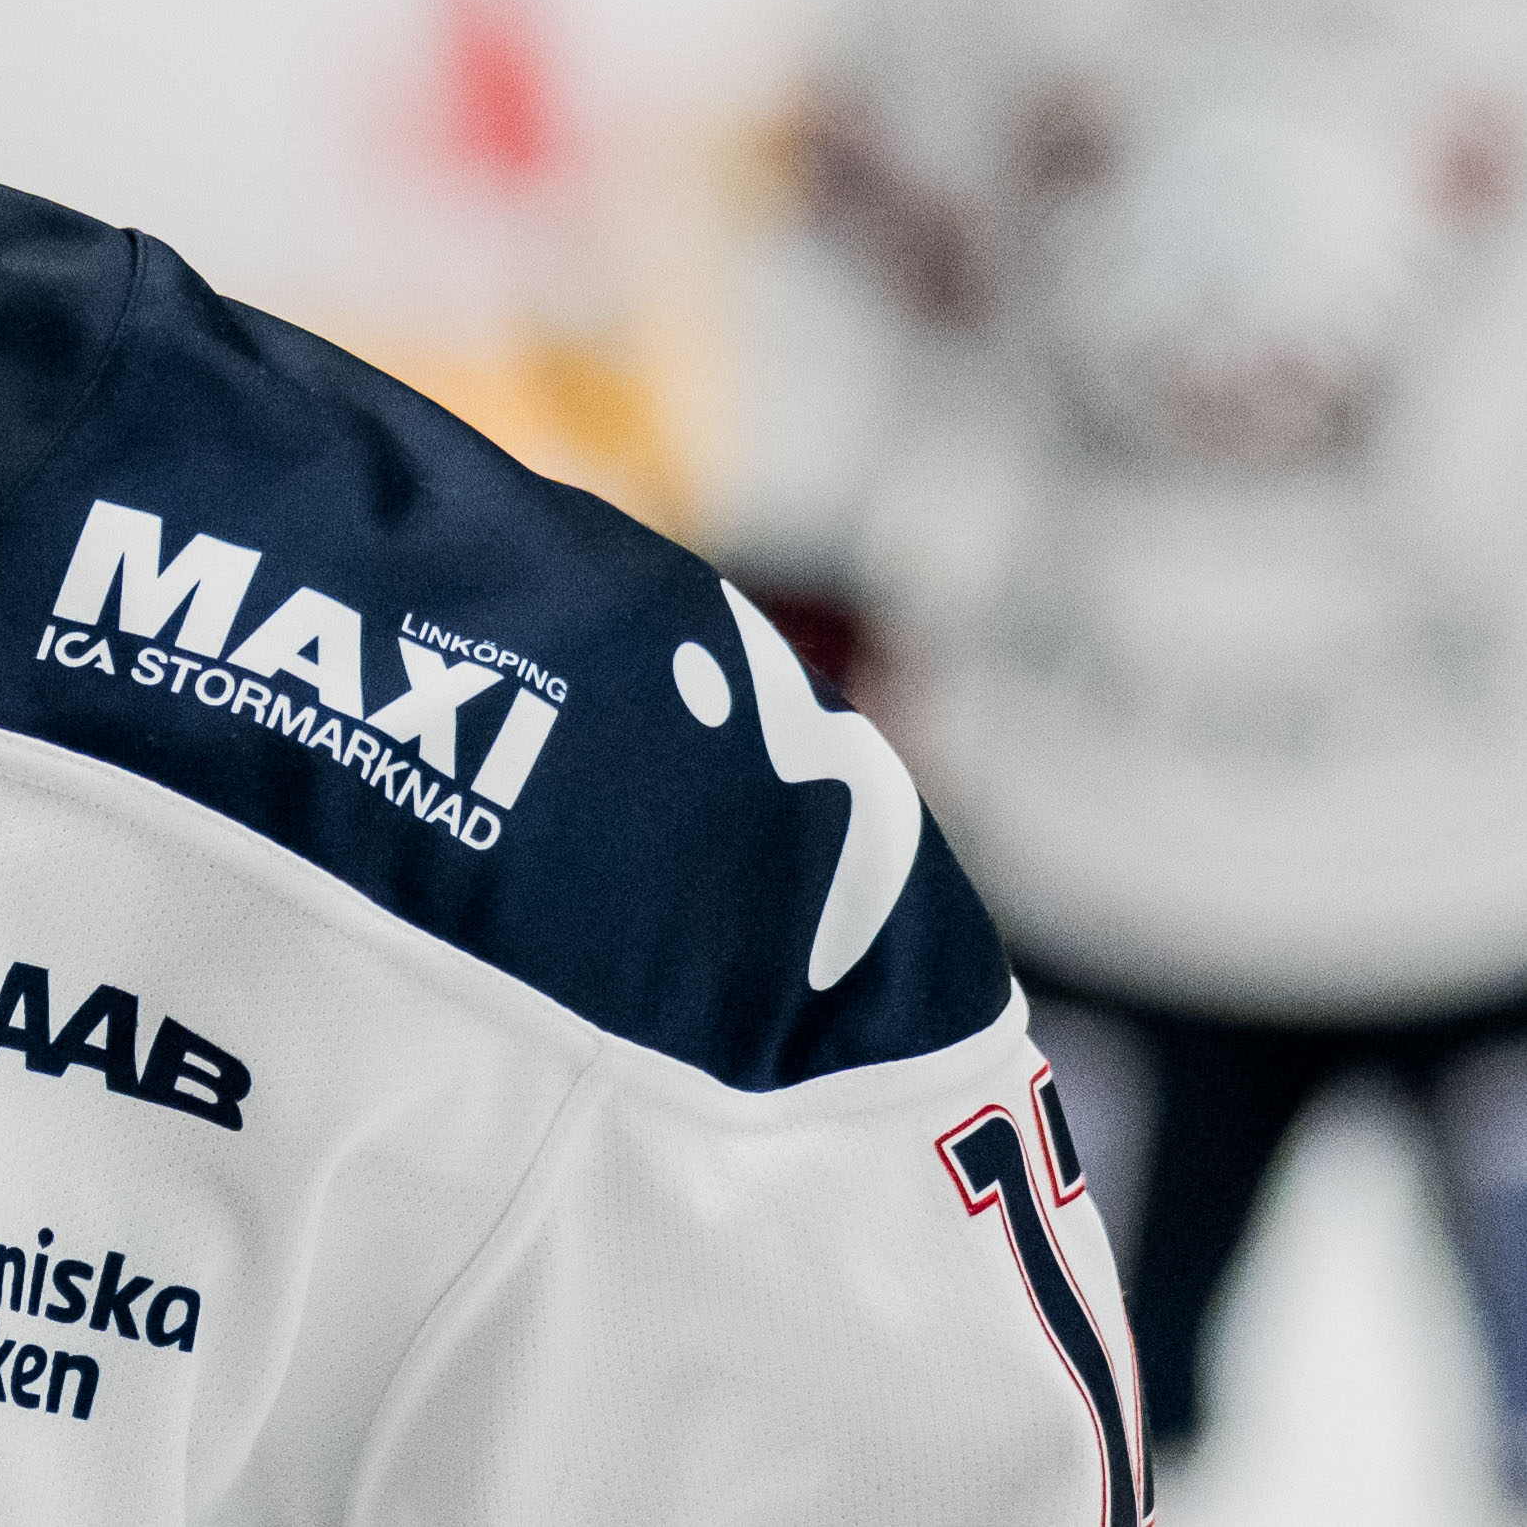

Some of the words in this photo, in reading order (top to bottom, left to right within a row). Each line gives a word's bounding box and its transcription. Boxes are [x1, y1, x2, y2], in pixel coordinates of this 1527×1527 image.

[35, 624, 115, 676] ICA
[130, 649, 502, 852] STORMARKNAD
[51, 499, 559, 811] MAXI
[400, 612, 569, 704] LINKÖPING
